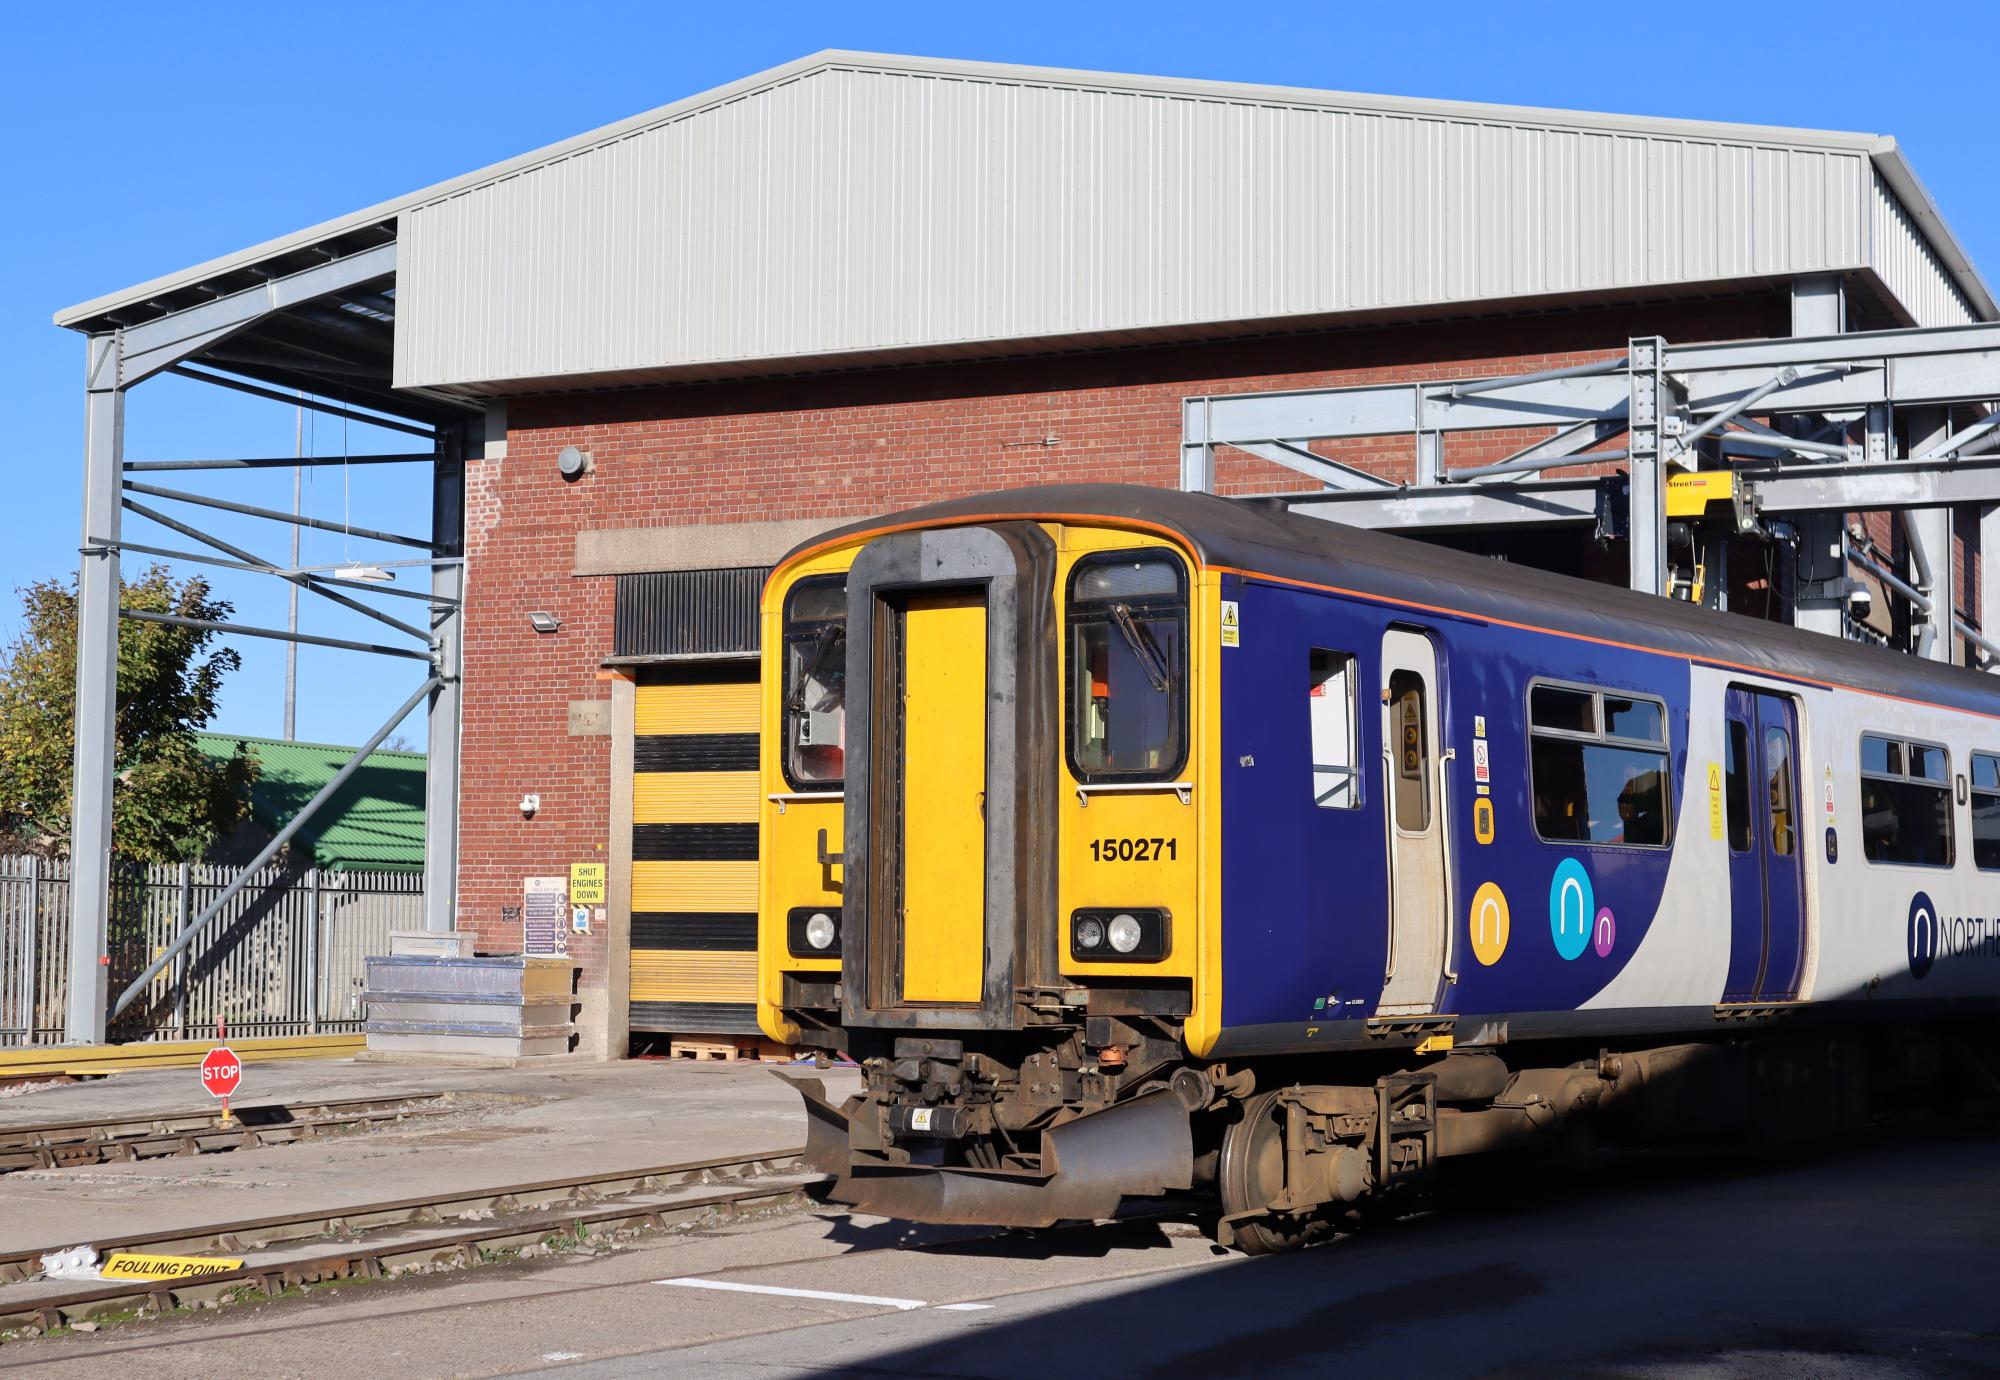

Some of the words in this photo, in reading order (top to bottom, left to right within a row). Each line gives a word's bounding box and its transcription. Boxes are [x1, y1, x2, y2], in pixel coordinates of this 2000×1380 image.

[1089, 837, 1176, 861] 150271
[578, 867, 597, 876] SHUT
[572, 879, 603, 888] ENGINES
[576, 890, 598, 899] DOWN
[204, 1065, 238, 1080] STOP
[112, 1260, 182, 1275] FOULING
